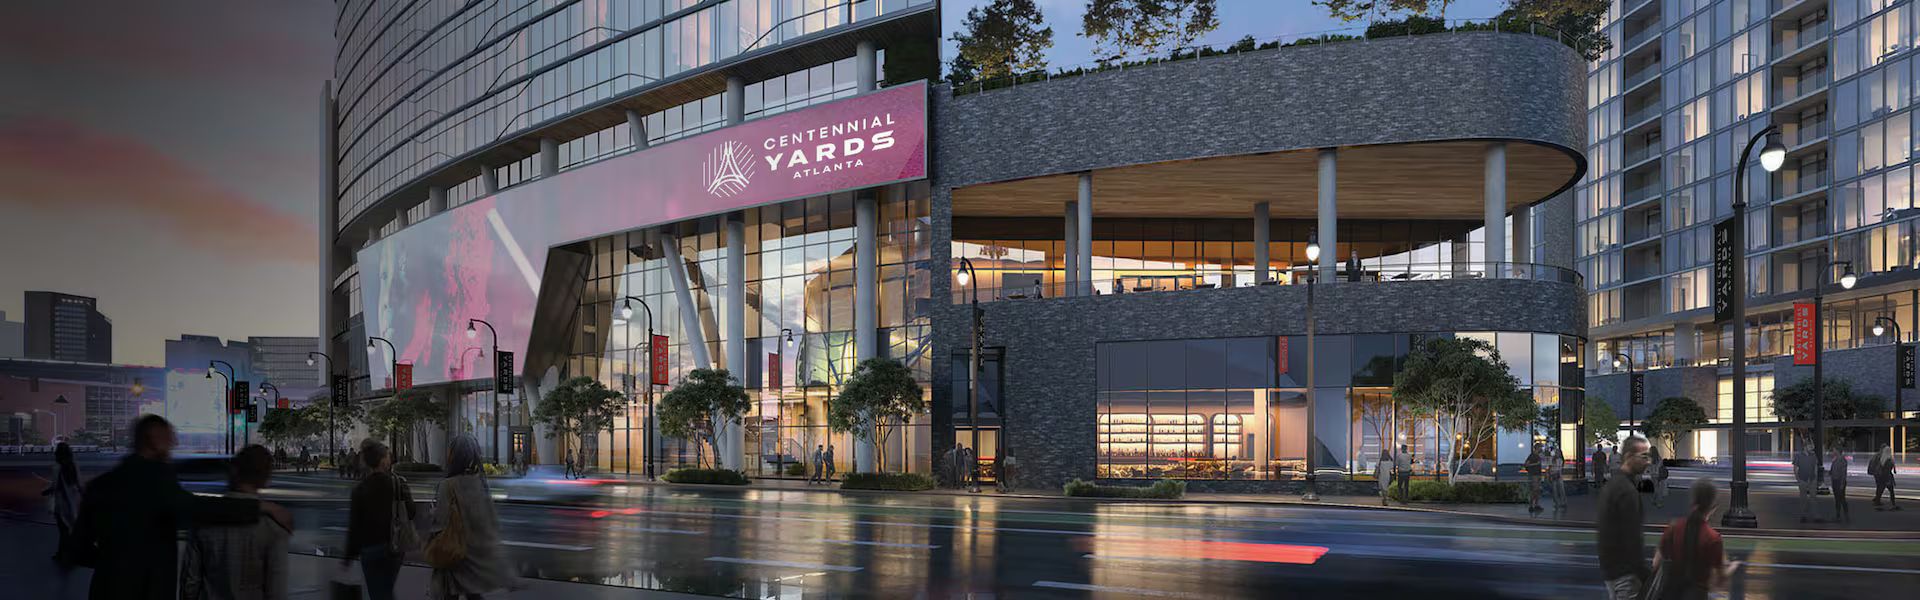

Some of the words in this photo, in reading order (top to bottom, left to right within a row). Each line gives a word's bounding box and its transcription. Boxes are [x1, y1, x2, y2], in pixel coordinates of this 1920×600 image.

[763, 113, 895, 151] CENTENNIAL
[764, 130, 895, 172] YARDS
[793, 158, 864, 179] ATLANTA
